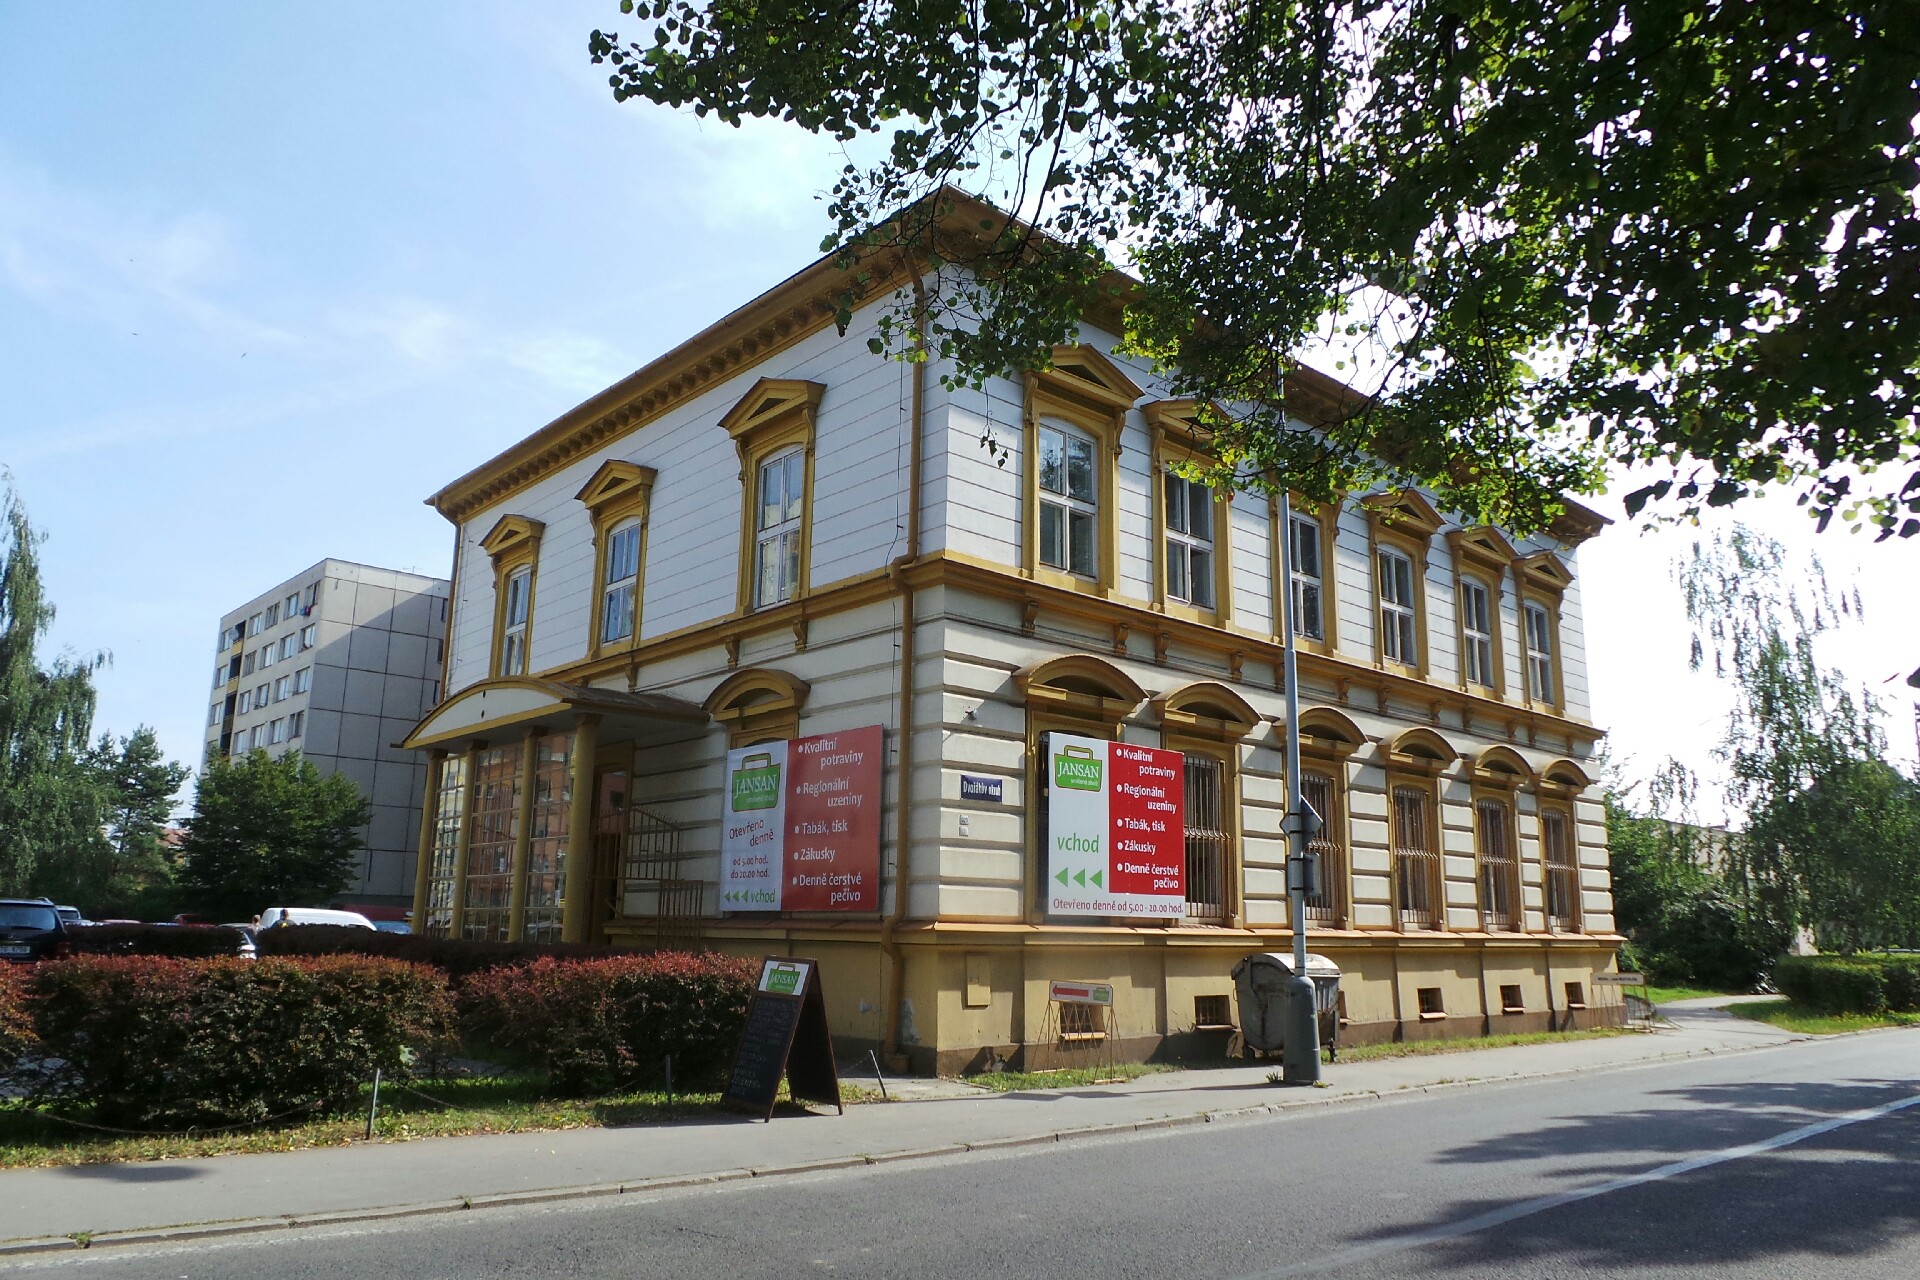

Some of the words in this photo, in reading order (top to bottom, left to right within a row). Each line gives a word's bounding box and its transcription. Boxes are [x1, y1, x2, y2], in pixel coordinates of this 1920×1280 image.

[804, 738, 837, 753] Kvalitní
[820, 750, 863, 770] potraviny
[1123, 748, 1153, 762] Kvalitní
[1058, 761, 1099, 778] JANSAN
[1139, 764, 1176, 780] potraviny
[734, 774, 776, 799] JANSAN
[803, 777, 849, 796] Regionální
[1124, 783, 1165, 799] Regionální
[827, 793, 863, 808] uzeniny
[1147, 801, 1177, 814] uzeniny
[729, 819, 764, 840] Otevřeno
[802, 821, 829, 836] Tabák,
[832, 819, 848, 832] tisk
[1125, 817, 1151, 832] Tabák,
[1152, 820, 1166, 832] tisk
[750, 828, 774, 847] denně
[1057, 832, 1099, 853] vchod
[800, 846, 836, 863] Zákusky
[1124, 840, 1156, 855] Zákusky
[733, 856, 741, 866] od
[754, 855, 769, 865] hod.
[730, 869, 739, 879] do
[739, 870, 756, 878] 20.00
[756, 868, 769, 878] hod.
[1124, 862, 1150, 875] Denně
[1151, 862, 1179, 876] čerstvé
[799, 872, 827, 886] Denně
[828, 872, 862, 885] čerstvé
[1153, 877, 1179, 890] pečivo
[750, 887, 776, 904] vchod
[830, 889, 861, 905] pečivo
[1053, 898, 1091, 910] Otevřeno
[1092, 899, 1116, 911] denně
[1117, 901, 1127, 911] od
[1128, 903, 1143, 914] 5.00
[1149, 904, 1167, 913] 20.00
[1168, 902, 1184, 914] hod.
